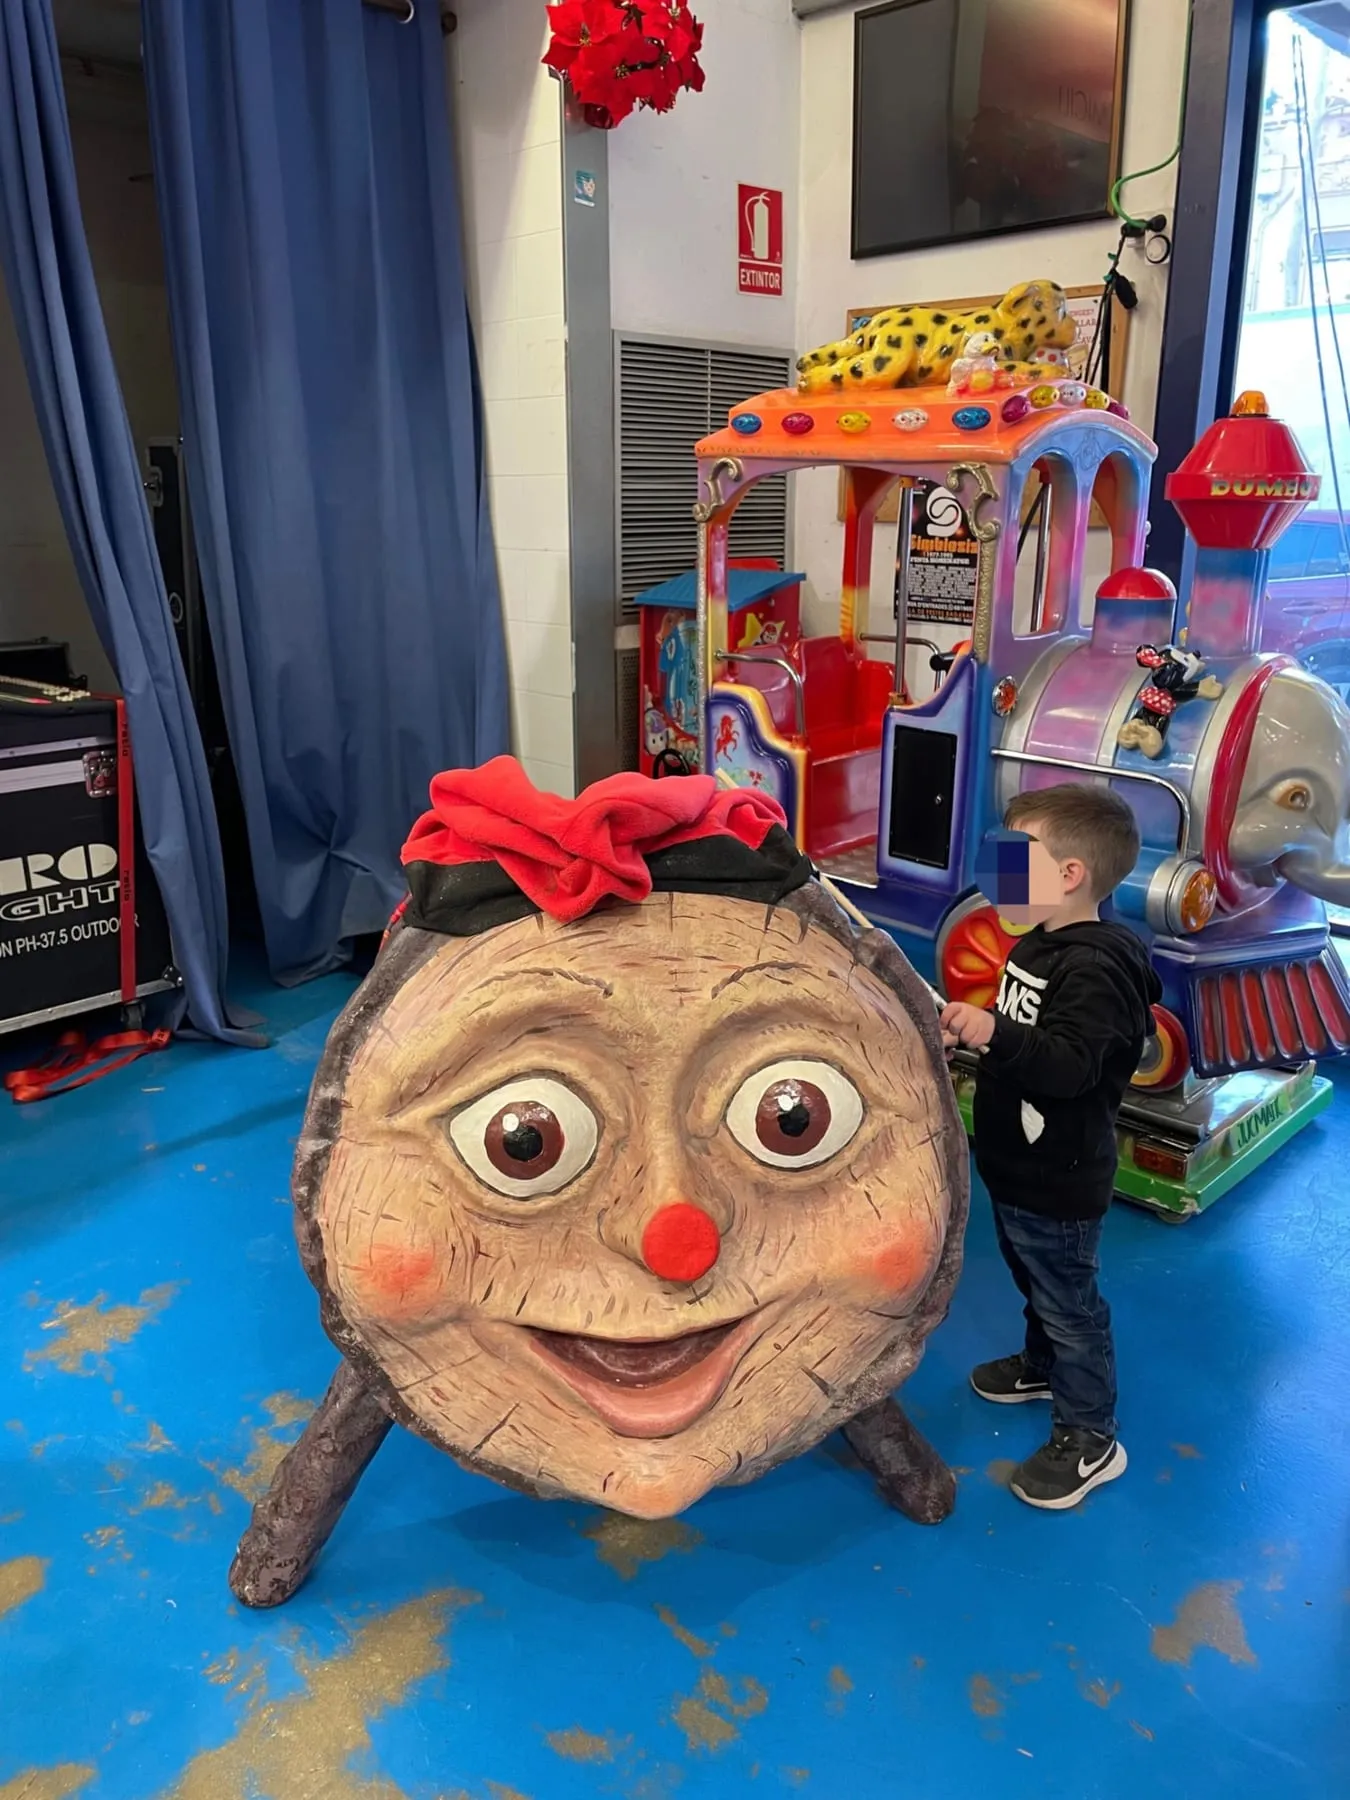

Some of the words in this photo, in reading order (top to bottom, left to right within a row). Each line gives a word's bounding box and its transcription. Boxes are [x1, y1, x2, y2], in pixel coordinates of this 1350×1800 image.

[740, 268, 781, 289] EXTINTOR
[1210, 479, 1312, 497] DUMBO
[15, 928, 69, 955] PH-37.5
